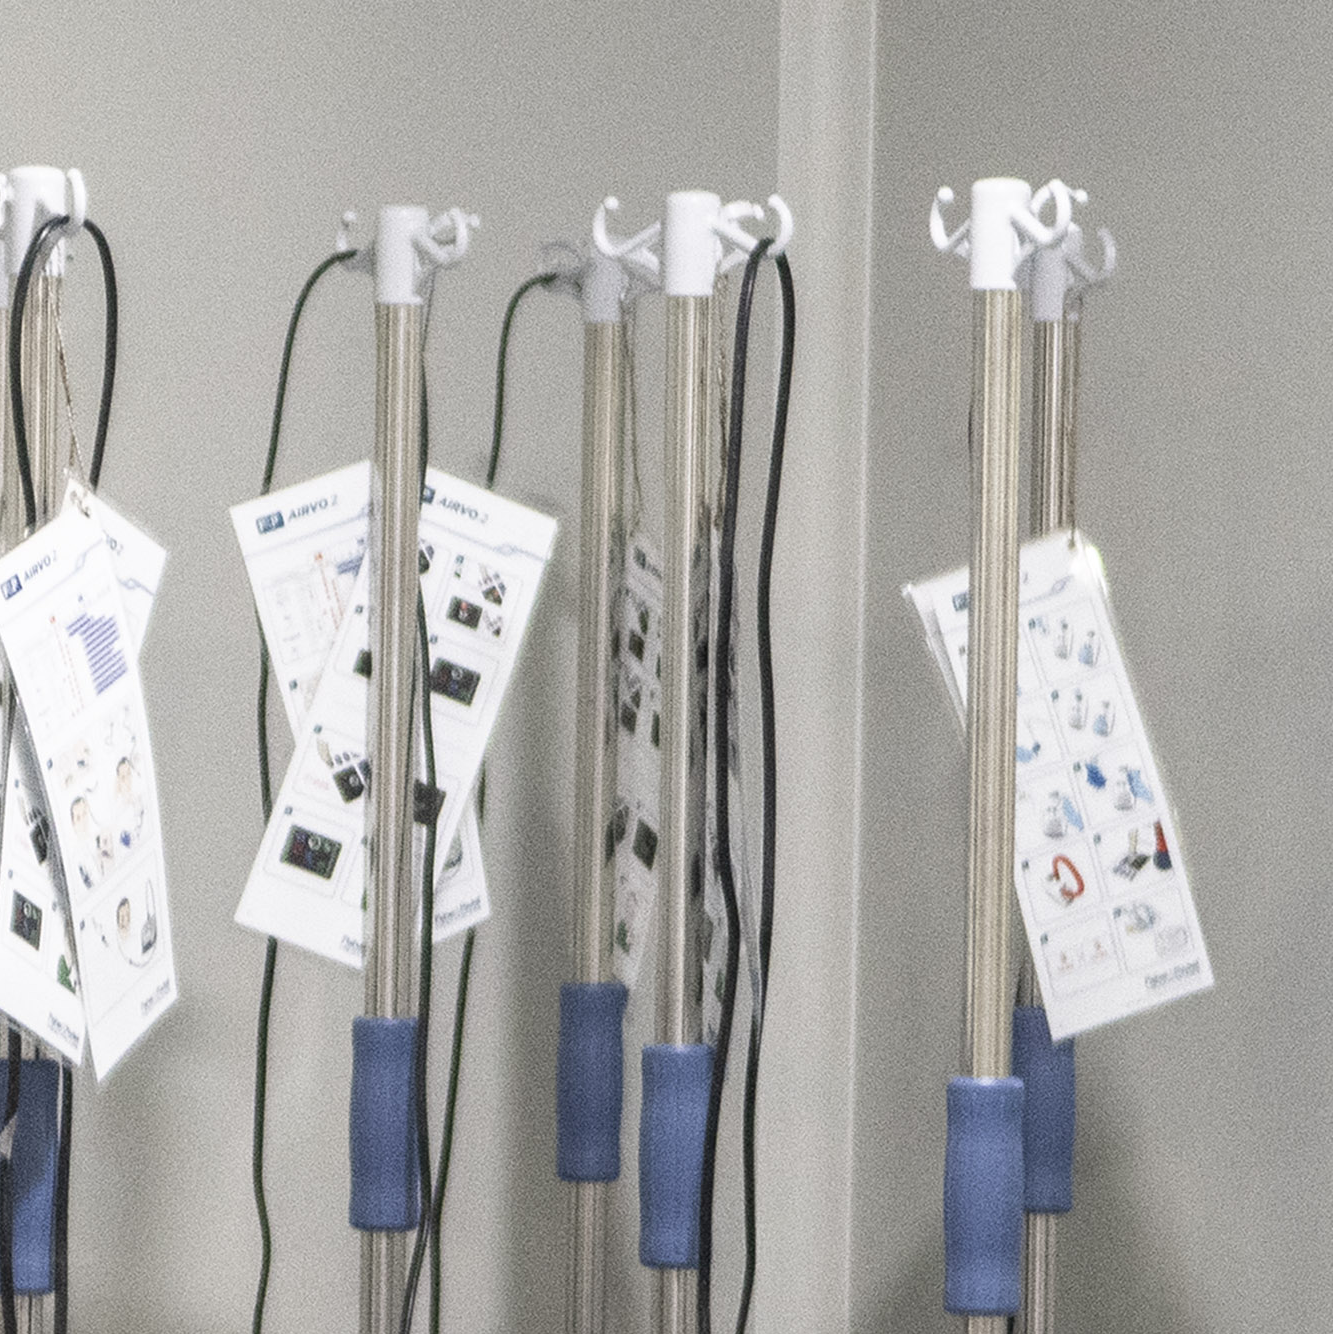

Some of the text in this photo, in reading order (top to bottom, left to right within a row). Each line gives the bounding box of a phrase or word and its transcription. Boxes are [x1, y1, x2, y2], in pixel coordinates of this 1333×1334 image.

[287, 499, 329, 521] AIRVO
[439, 496, 479, 520] AIRVO
[23, 554, 52, 583] AIRVO
